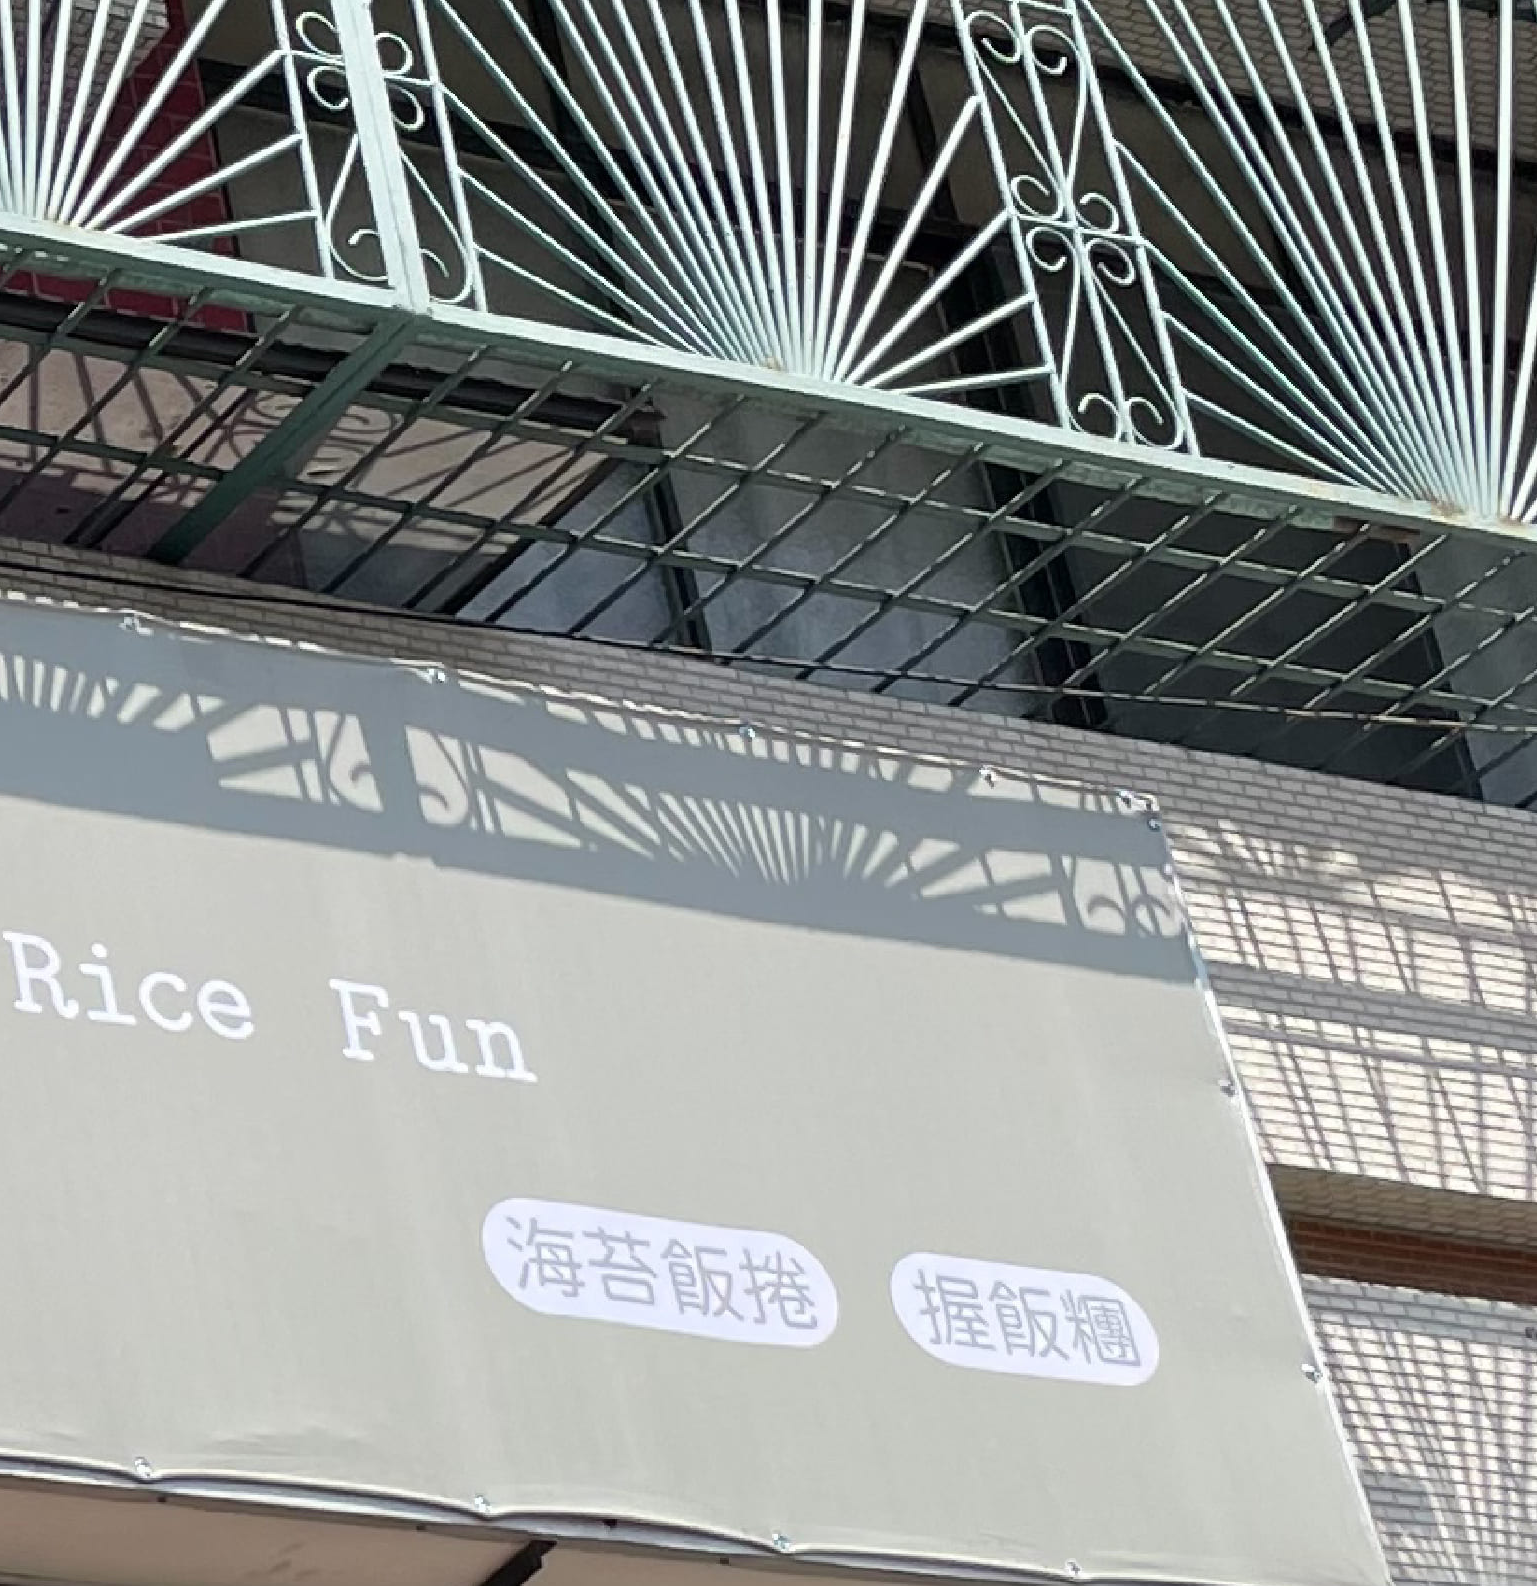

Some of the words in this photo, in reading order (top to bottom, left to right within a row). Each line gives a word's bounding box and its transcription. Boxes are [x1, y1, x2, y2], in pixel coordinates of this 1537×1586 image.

[2, 930, 256, 1041] Rice
[327, 976, 539, 1084] Fun
[504, 1215, 820, 1332] 海苔飯捲
[911, 1268, 1144, 1370] 握飯糰
